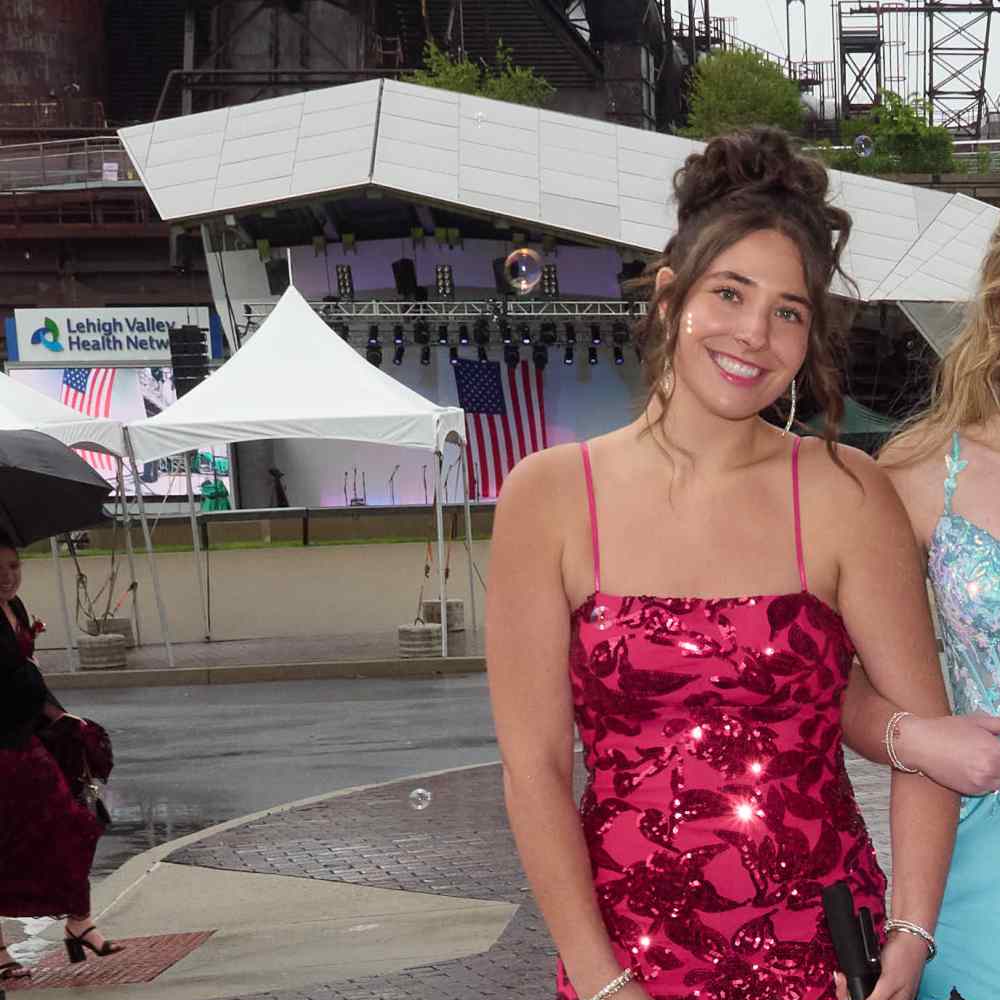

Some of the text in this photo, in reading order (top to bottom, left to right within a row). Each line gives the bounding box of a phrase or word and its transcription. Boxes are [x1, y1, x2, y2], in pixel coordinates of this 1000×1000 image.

[66, 316, 176, 336] Lehigh Valley
[68, 335, 169, 351] Health Netw
